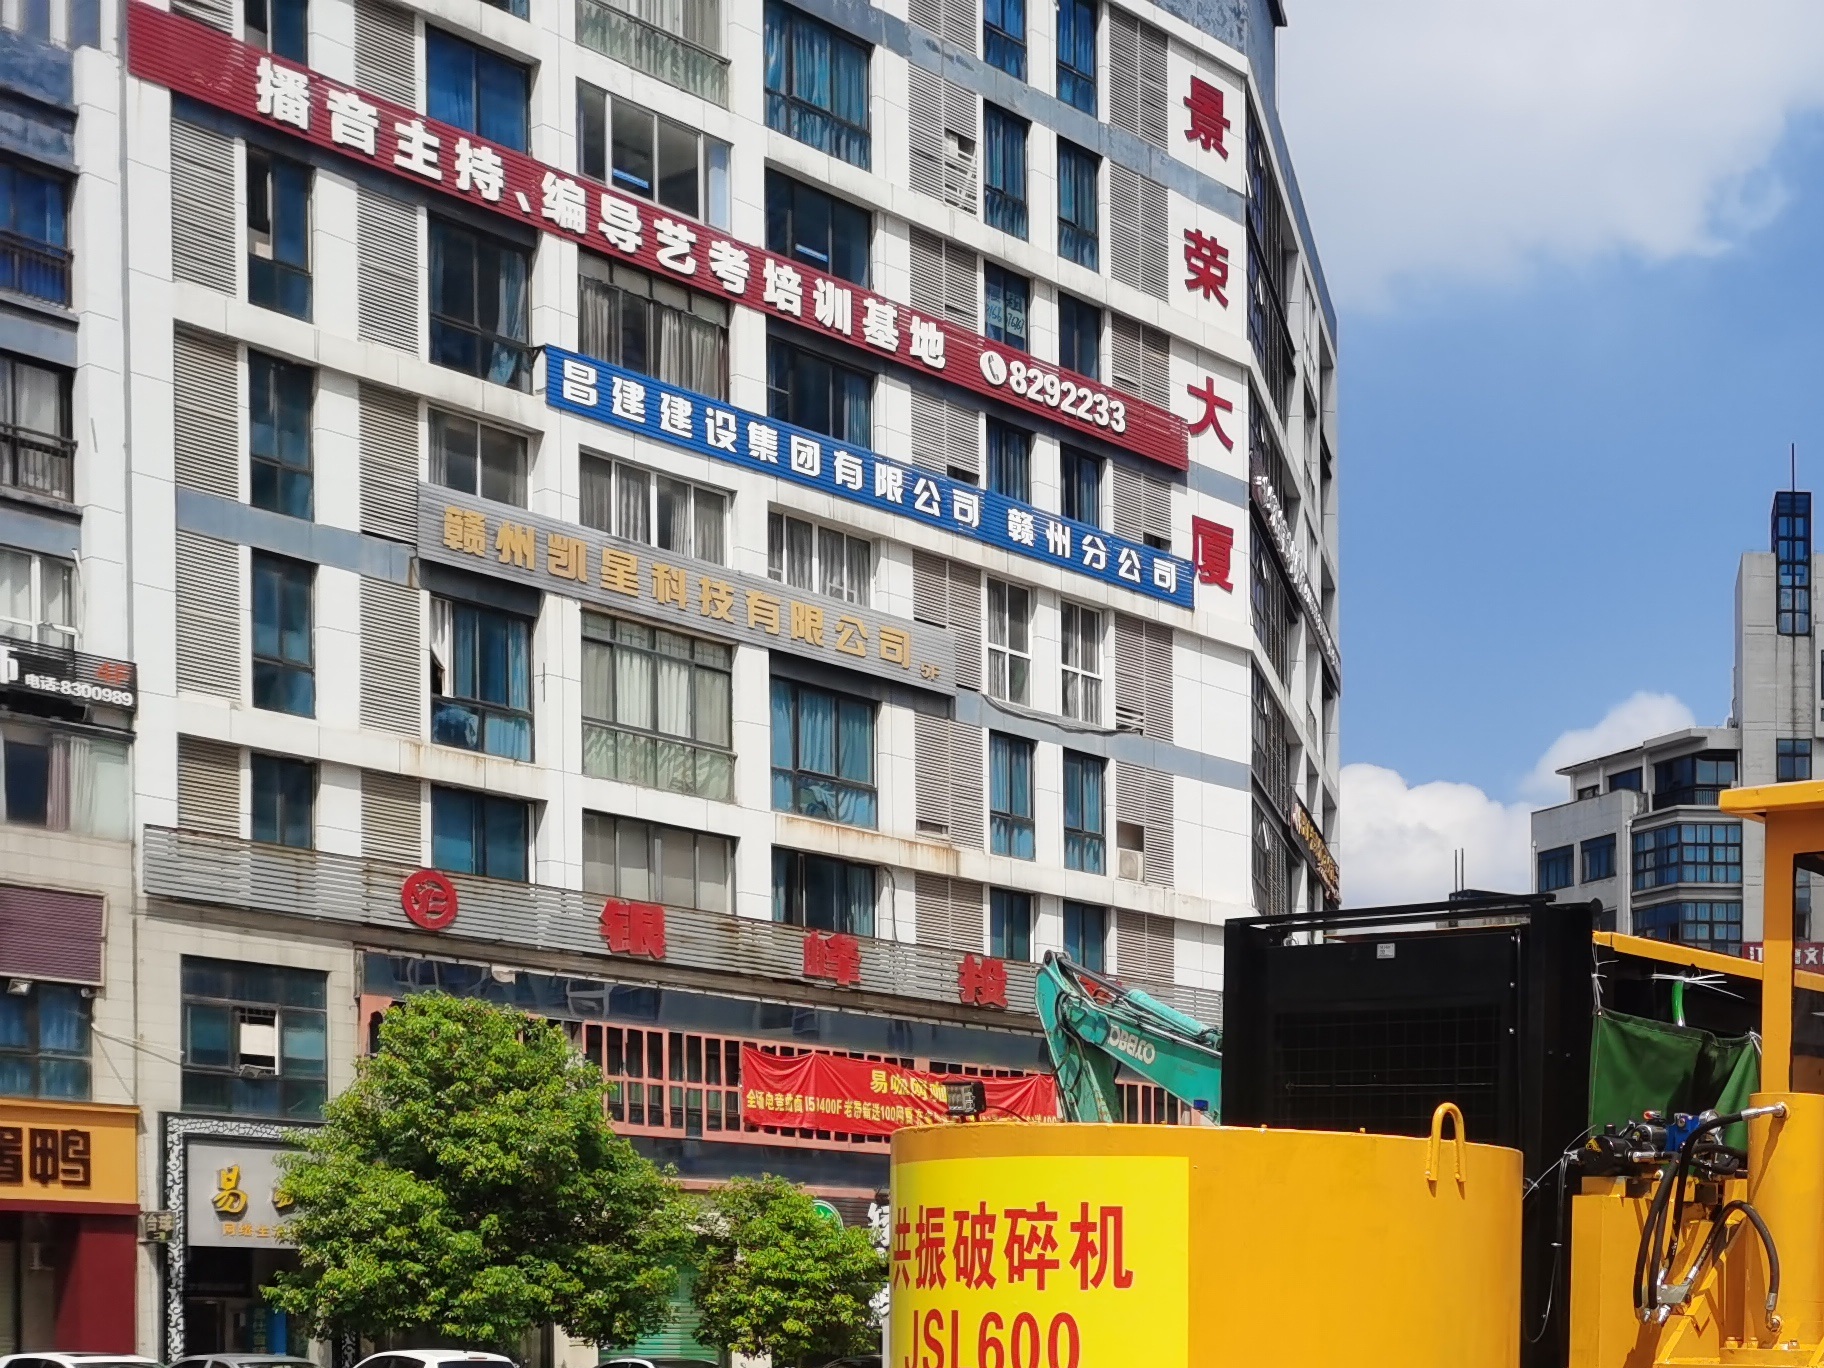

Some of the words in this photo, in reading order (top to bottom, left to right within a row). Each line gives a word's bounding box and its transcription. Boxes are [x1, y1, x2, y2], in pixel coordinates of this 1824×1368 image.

[256, 58, 945, 369] 播音主持、编导艺考培训基地
[1009, 361, 1126, 433] 8292233
[1183, 75, 1234, 593] 景荣大厦
[443, 506, 912, 669] 赣州凯星科技有限公司
[563, 359, 979, 528] 昌建建设集团有限公司
[1007, 508, 1177, 594] 赣州分公司
[893, 1200, 1134, 1292] 共振破碎机
